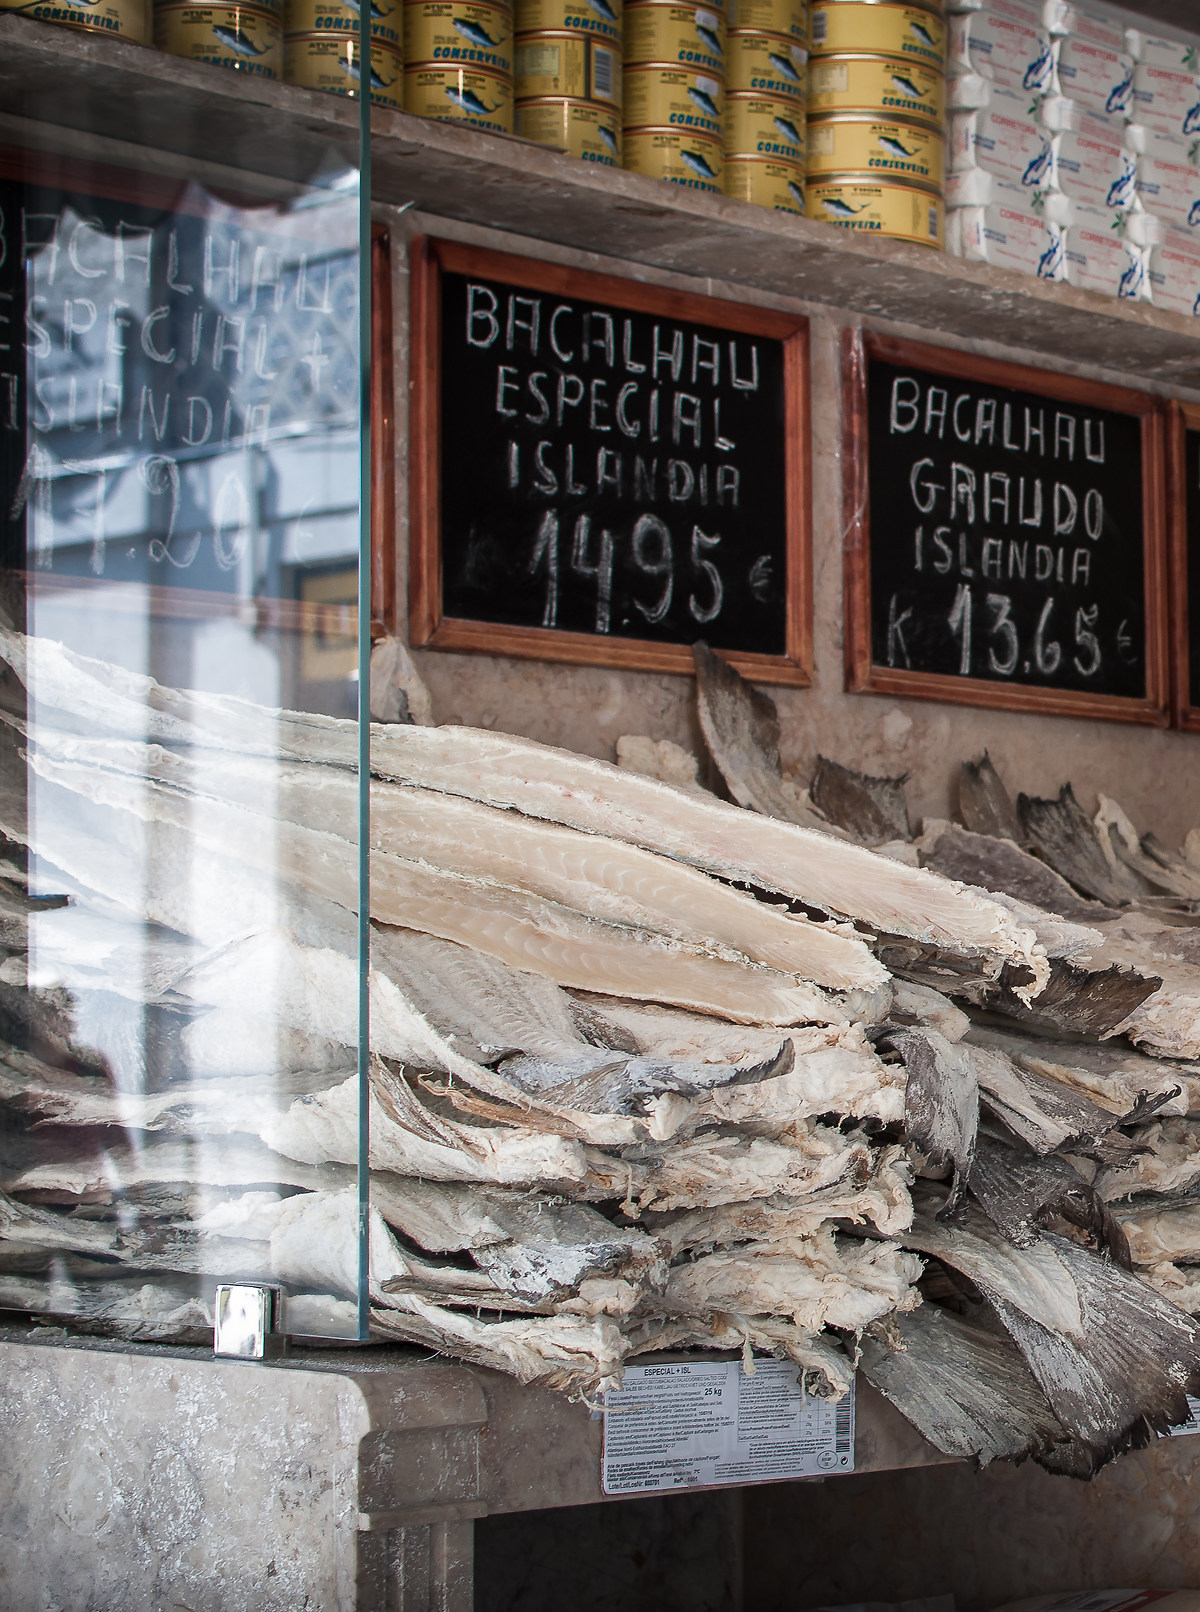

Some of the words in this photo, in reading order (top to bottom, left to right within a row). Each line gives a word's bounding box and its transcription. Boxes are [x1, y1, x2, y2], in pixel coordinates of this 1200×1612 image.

[33, 6, 120, 32] CONSERVEIRA
[868, 158, 929, 176] CONSERVEIRA
[466, 282, 759, 391] BACALHAU
[496, 365, 736, 451] ESPECIAL
[889, 377, 1105, 463] BACALHAU
[508, 440, 740, 506] ISLANDIA
[910, 457, 1104, 540] GRAUDO
[527, 508, 724, 633] 14.95
[914, 526, 1091, 586] ISLANDIA
[887, 593, 913, 669] K
[644, 1368, 675, 1376] ESPECIAL
[681, 1366, 691, 1374] ISL
[714, 1388, 722, 1396] kg
